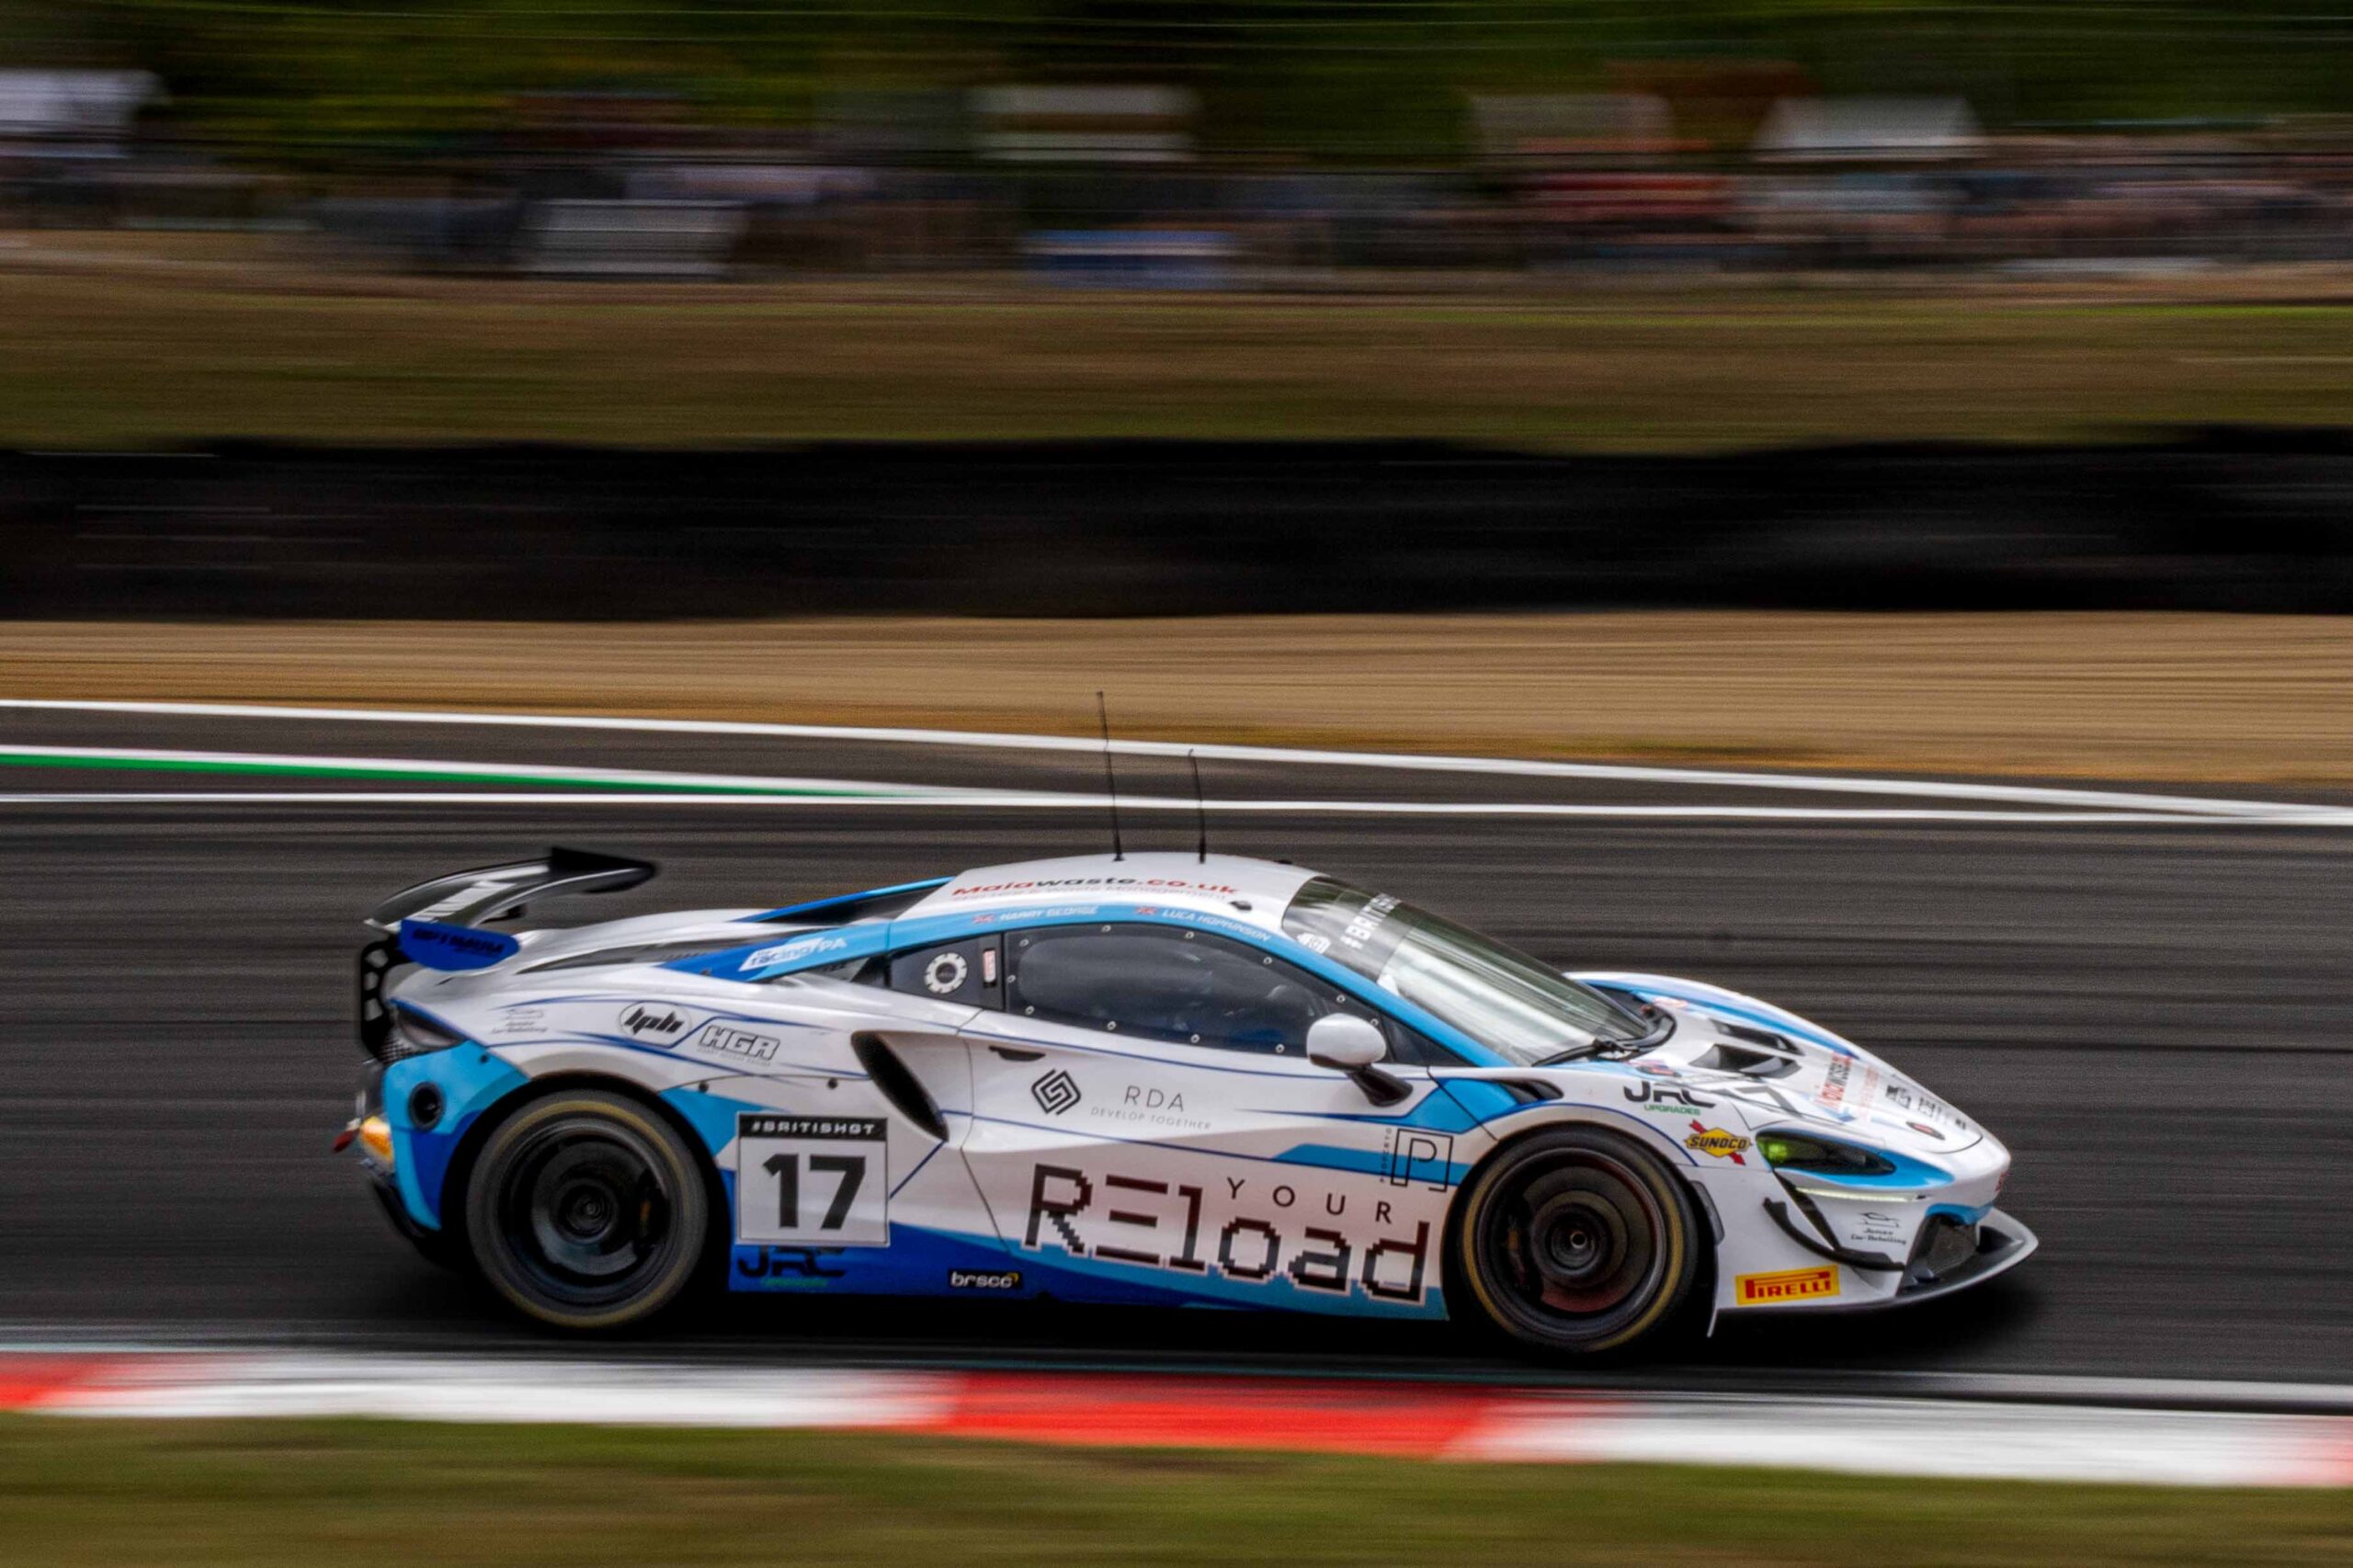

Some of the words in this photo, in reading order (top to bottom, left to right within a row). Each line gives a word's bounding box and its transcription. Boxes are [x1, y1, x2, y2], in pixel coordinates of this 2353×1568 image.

[1162, 908, 1196, 922] LUCA
[699, 1025, 780, 1061] HGR
[1124, 1085, 1185, 1112] RDA
[1643, 1104, 1701, 1116] UPGRADES
[751, 1120, 875, 1134] #BRITISHGT
[1090, 1106, 1146, 1121] DEVELOP
[1150, 1113, 1211, 1130] TOGETHER
[1689, 1135, 1748, 1150] SUNOCO
[762, 1153, 867, 1231] 17
[1227, 1176, 1392, 1224] YOUR
[1745, 1271, 1831, 1299] PIRELLI
